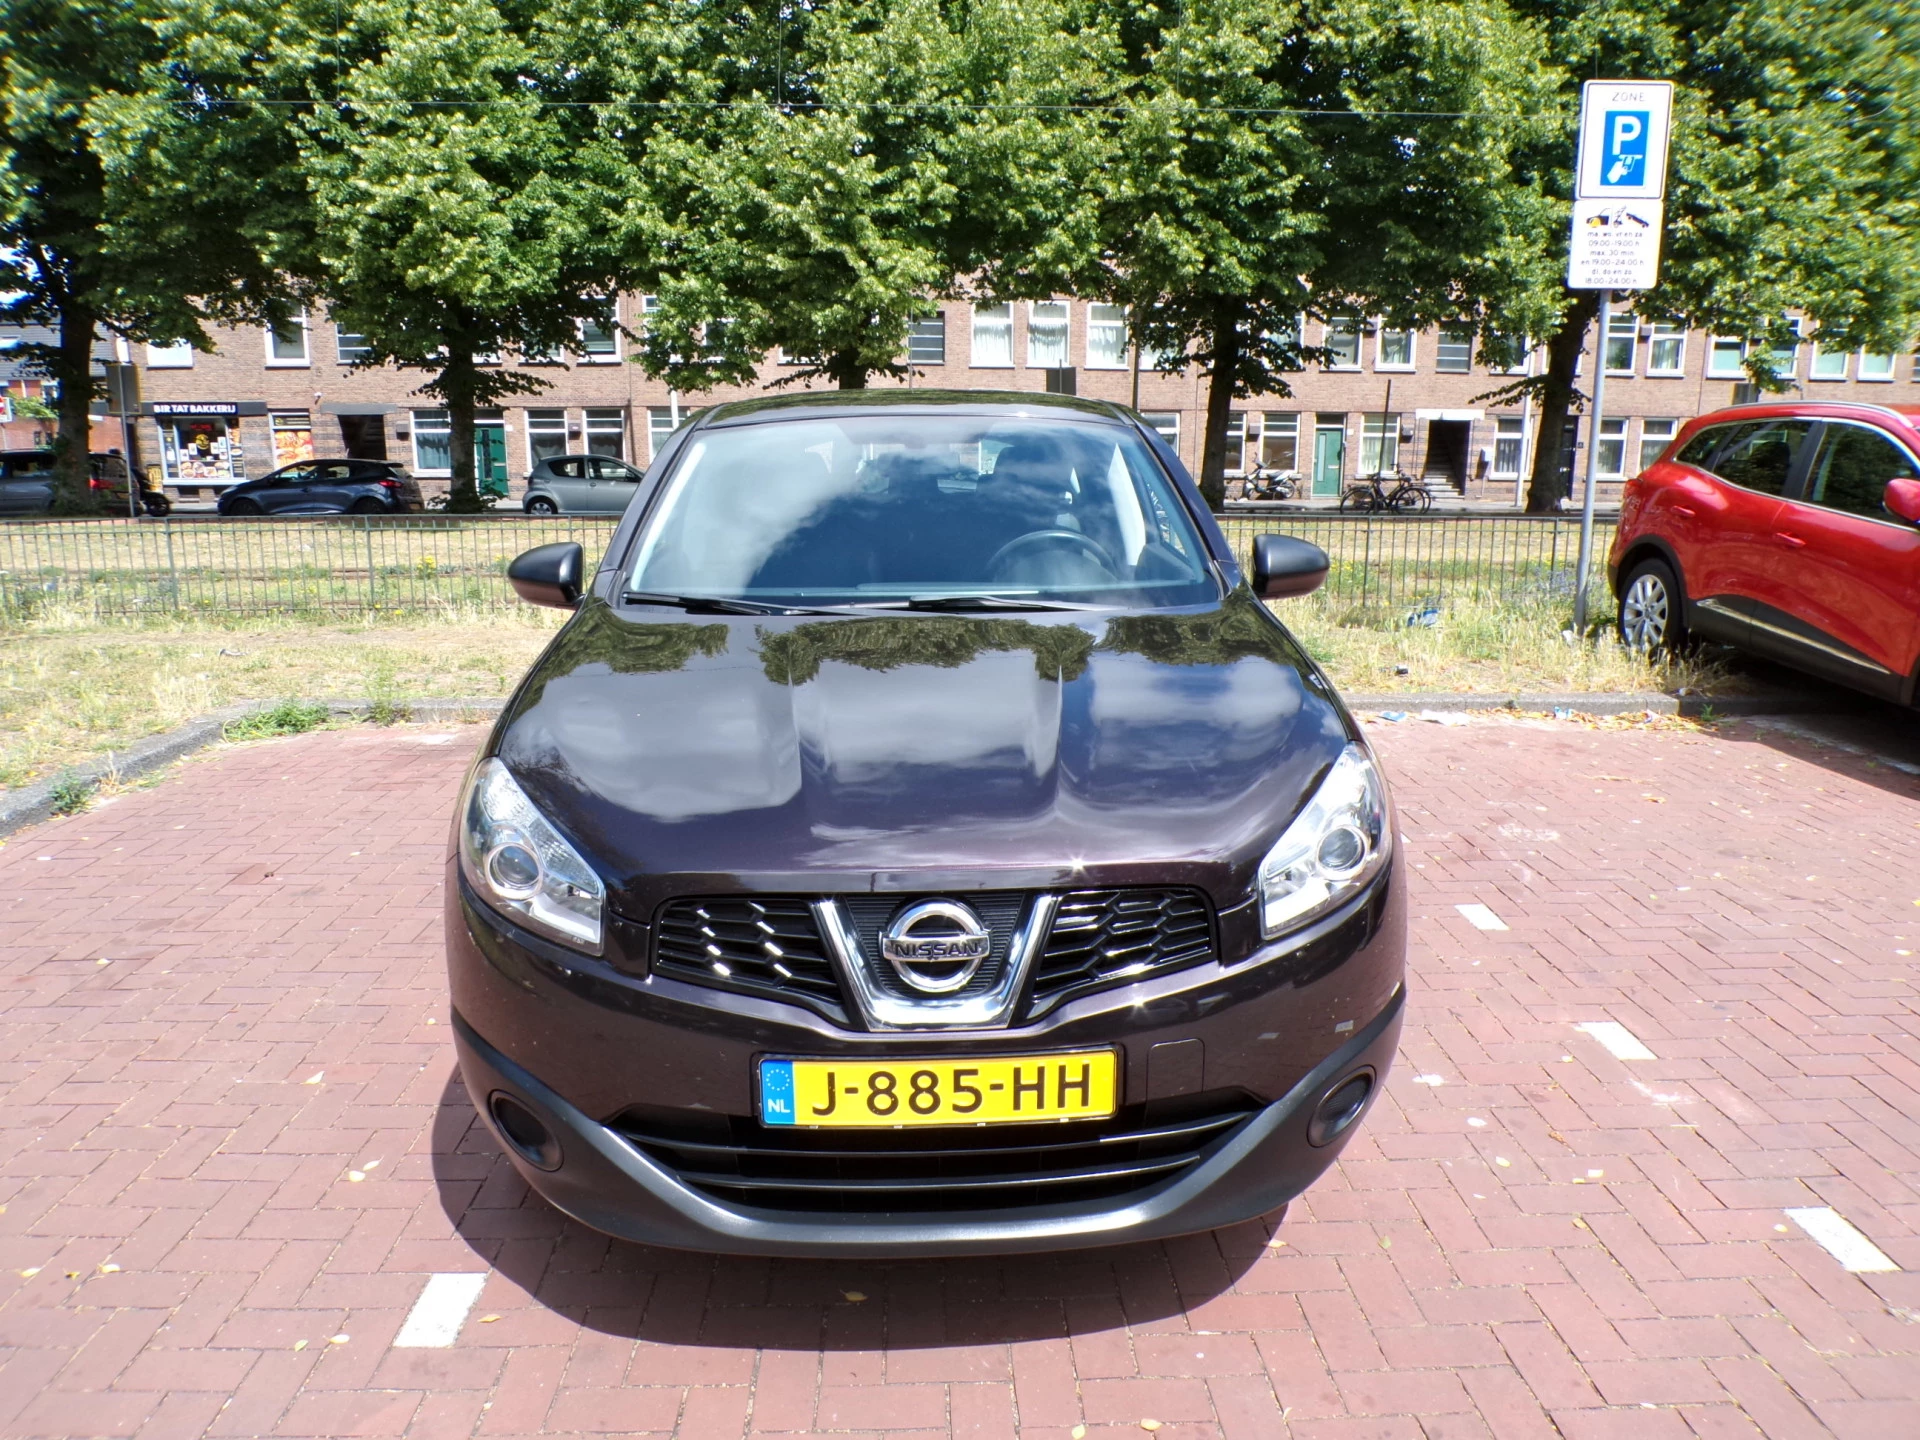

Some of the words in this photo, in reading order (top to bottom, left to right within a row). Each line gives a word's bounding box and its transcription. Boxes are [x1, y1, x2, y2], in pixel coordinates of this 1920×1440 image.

[1612, 91, 1645, 102] ZONE
[1612, 115, 1642, 156] P
[153, 404, 171, 413] BIR
[171, 404, 189, 413] TAT
[190, 404, 236, 413] BAKKERIJ
[894, 941, 980, 958] NISSAN
[811, 1063, 1091, 1117] J-885-HH
[767, 1098, 791, 1114] NL
